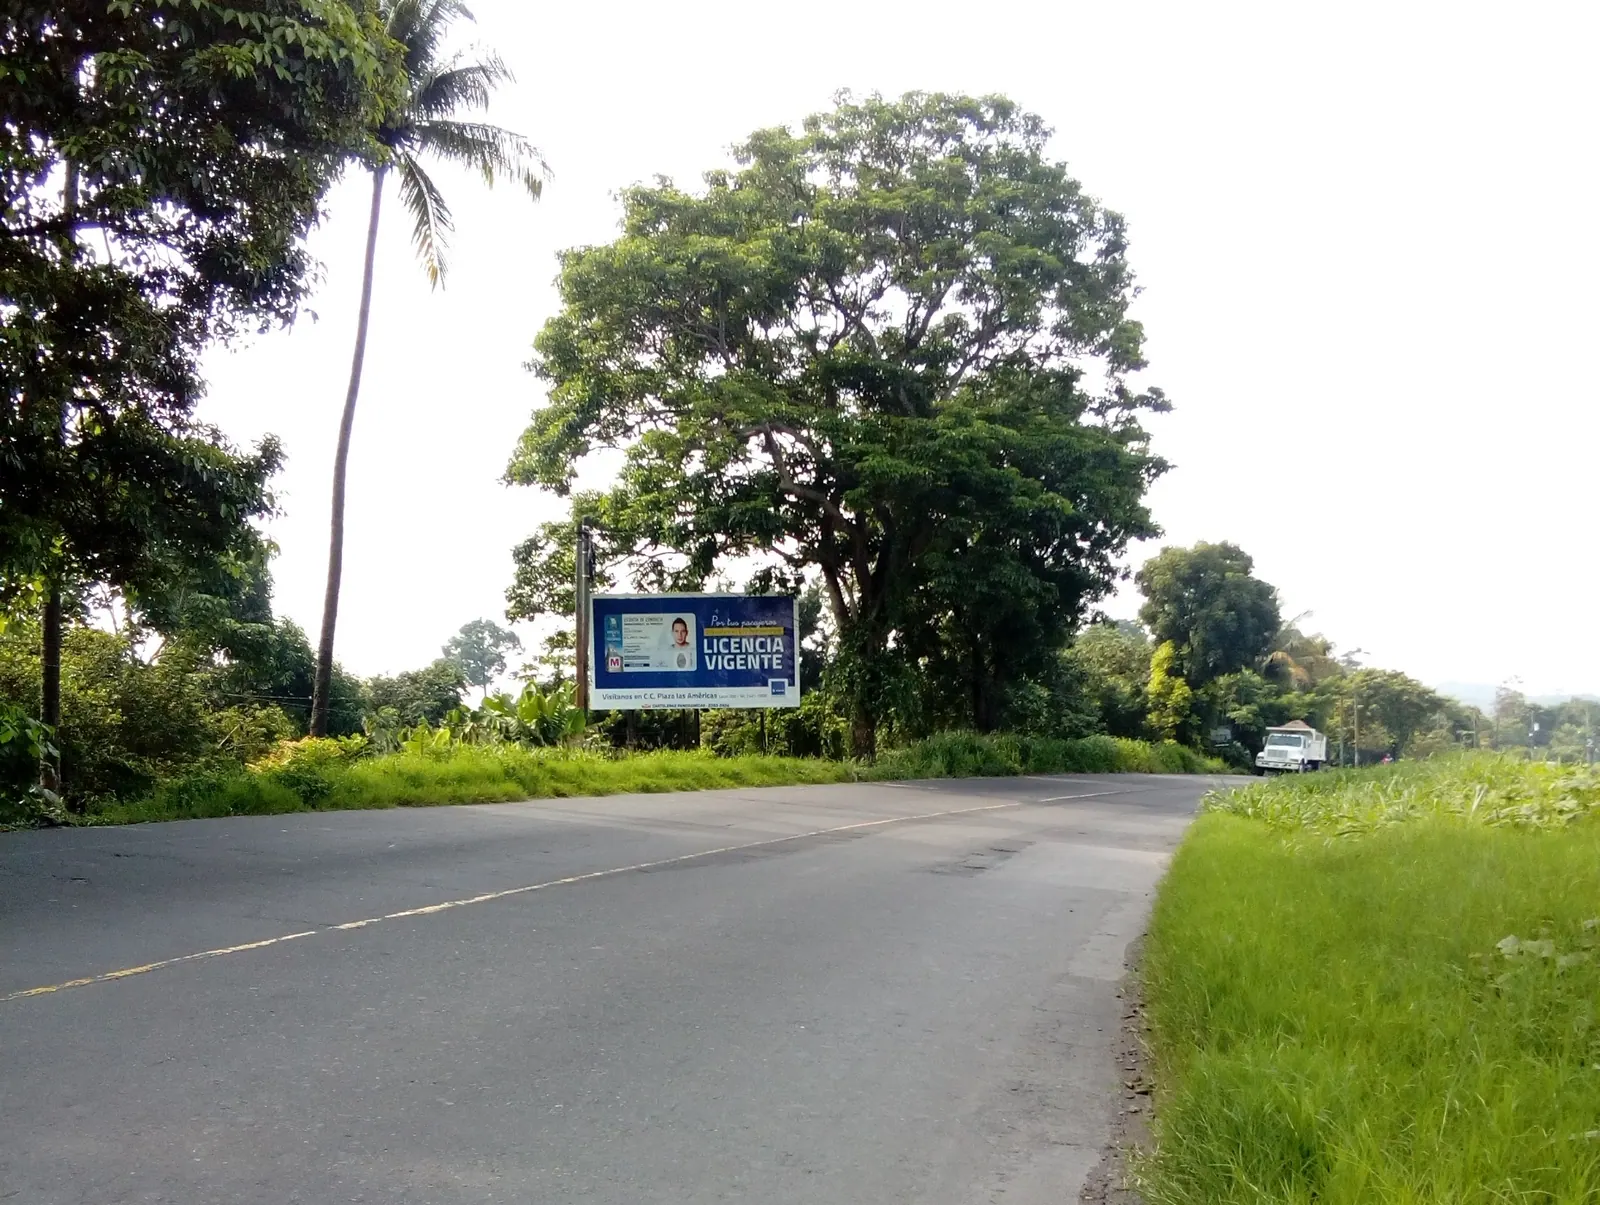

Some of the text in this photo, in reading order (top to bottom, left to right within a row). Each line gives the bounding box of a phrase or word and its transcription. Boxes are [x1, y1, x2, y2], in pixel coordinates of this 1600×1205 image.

[711, 615, 725, 627] Por
[703, 637, 784, 654] LICENCIA
[610, 658, 620, 667] M
[704, 654, 783, 670] VIGENTE
[687, 691, 718, 699] Américas
